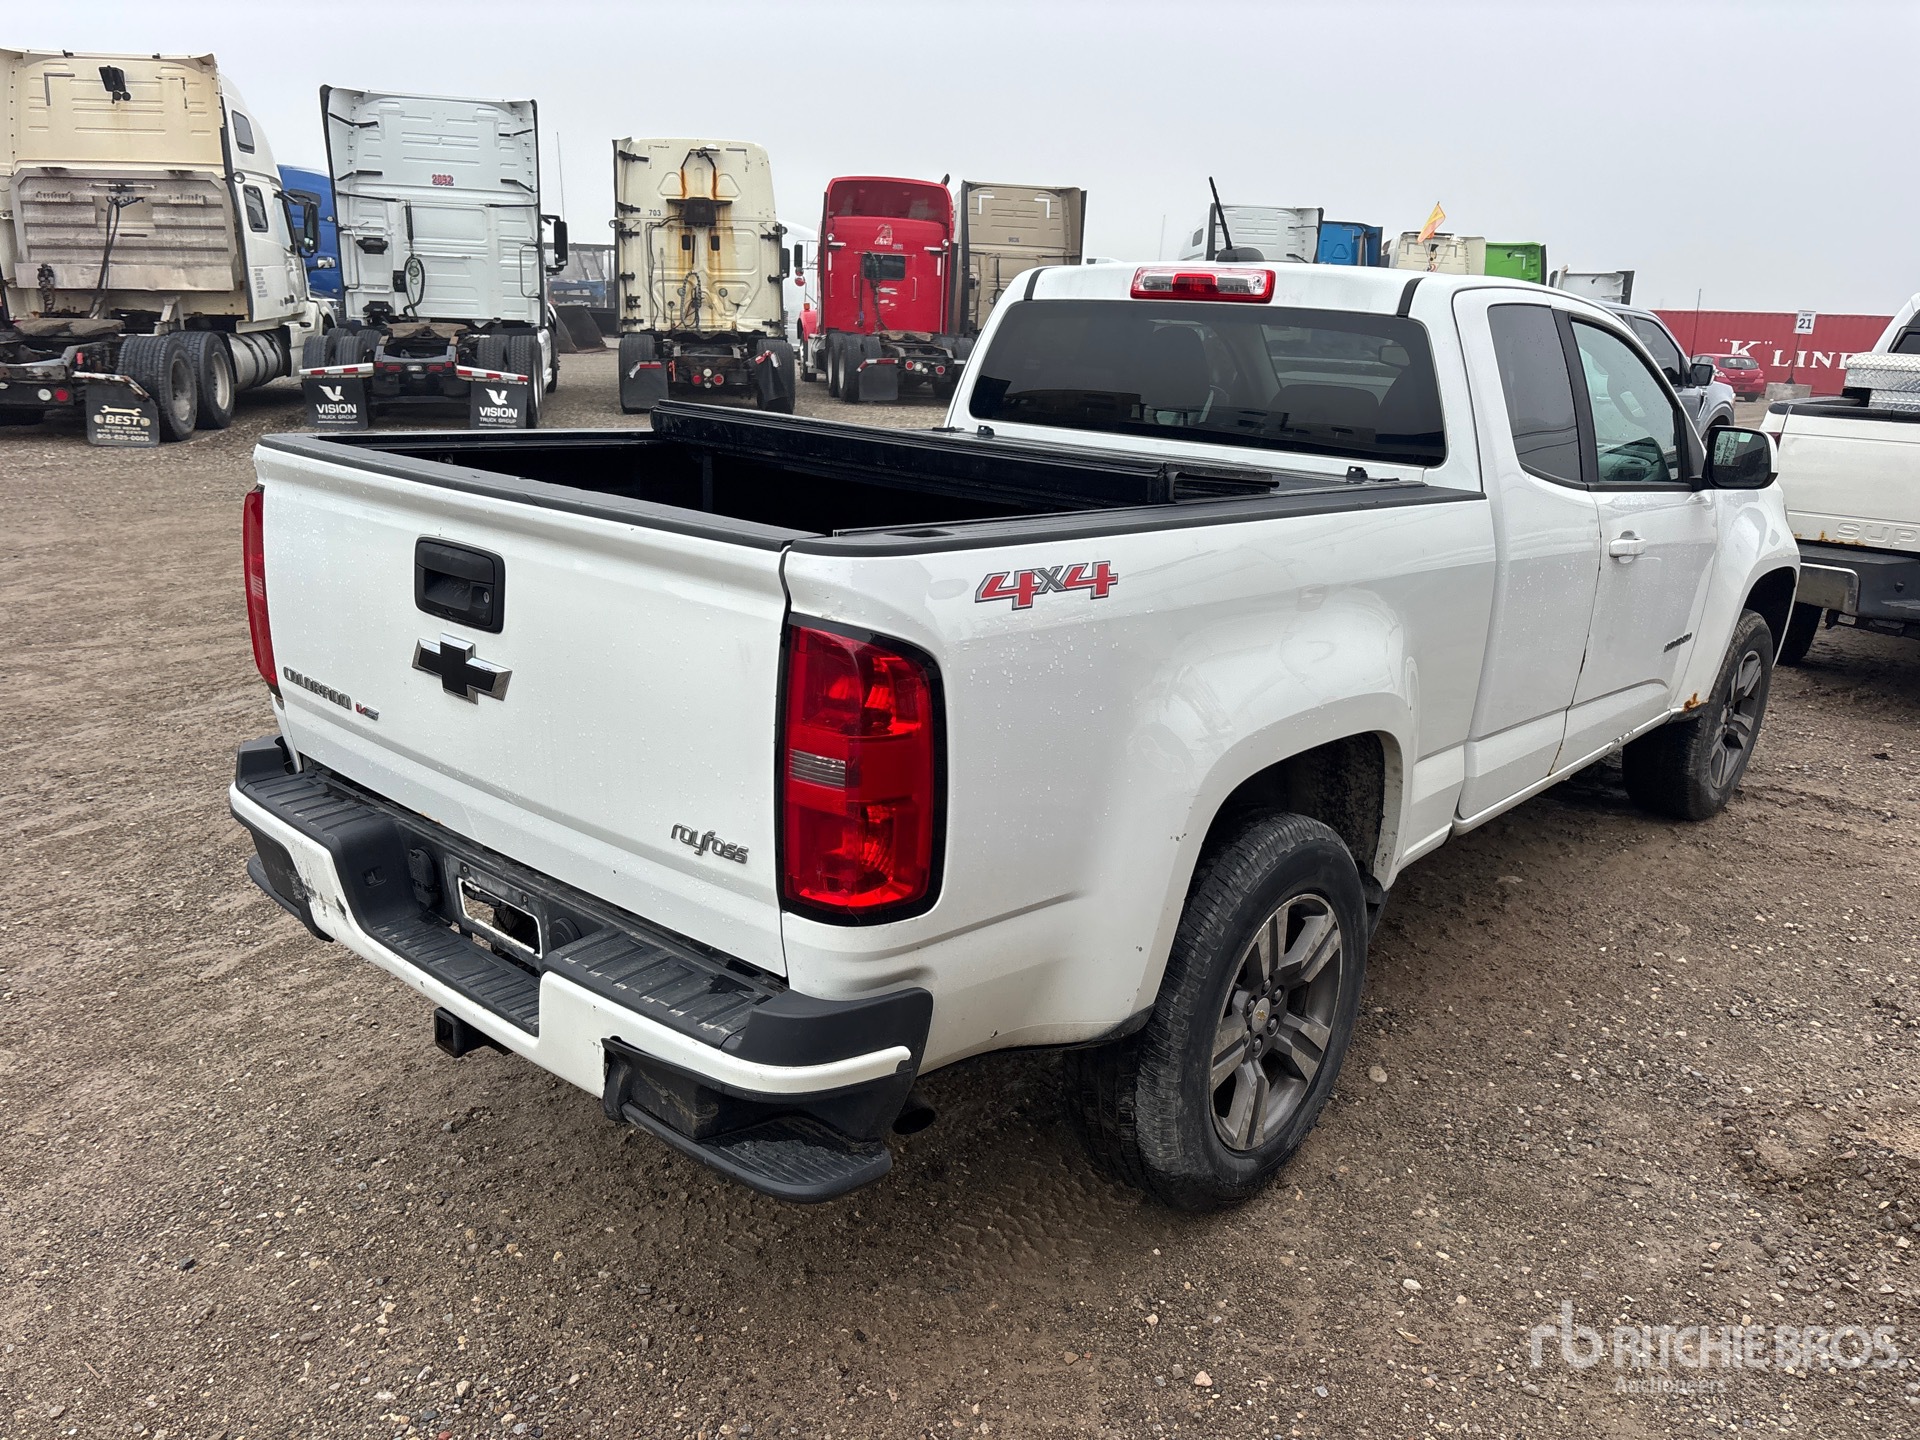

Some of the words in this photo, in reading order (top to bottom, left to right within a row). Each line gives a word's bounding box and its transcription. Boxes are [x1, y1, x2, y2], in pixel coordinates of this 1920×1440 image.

[648, 209, 662, 217] 703
[1797, 317, 1812, 330] 21
[315, 403, 357, 414] VISION
[479, 406, 518, 418] VISION
[105, 415, 141, 426] BEST
[283, 665, 352, 711] COLORADO
[355, 701, 380, 722] V6
